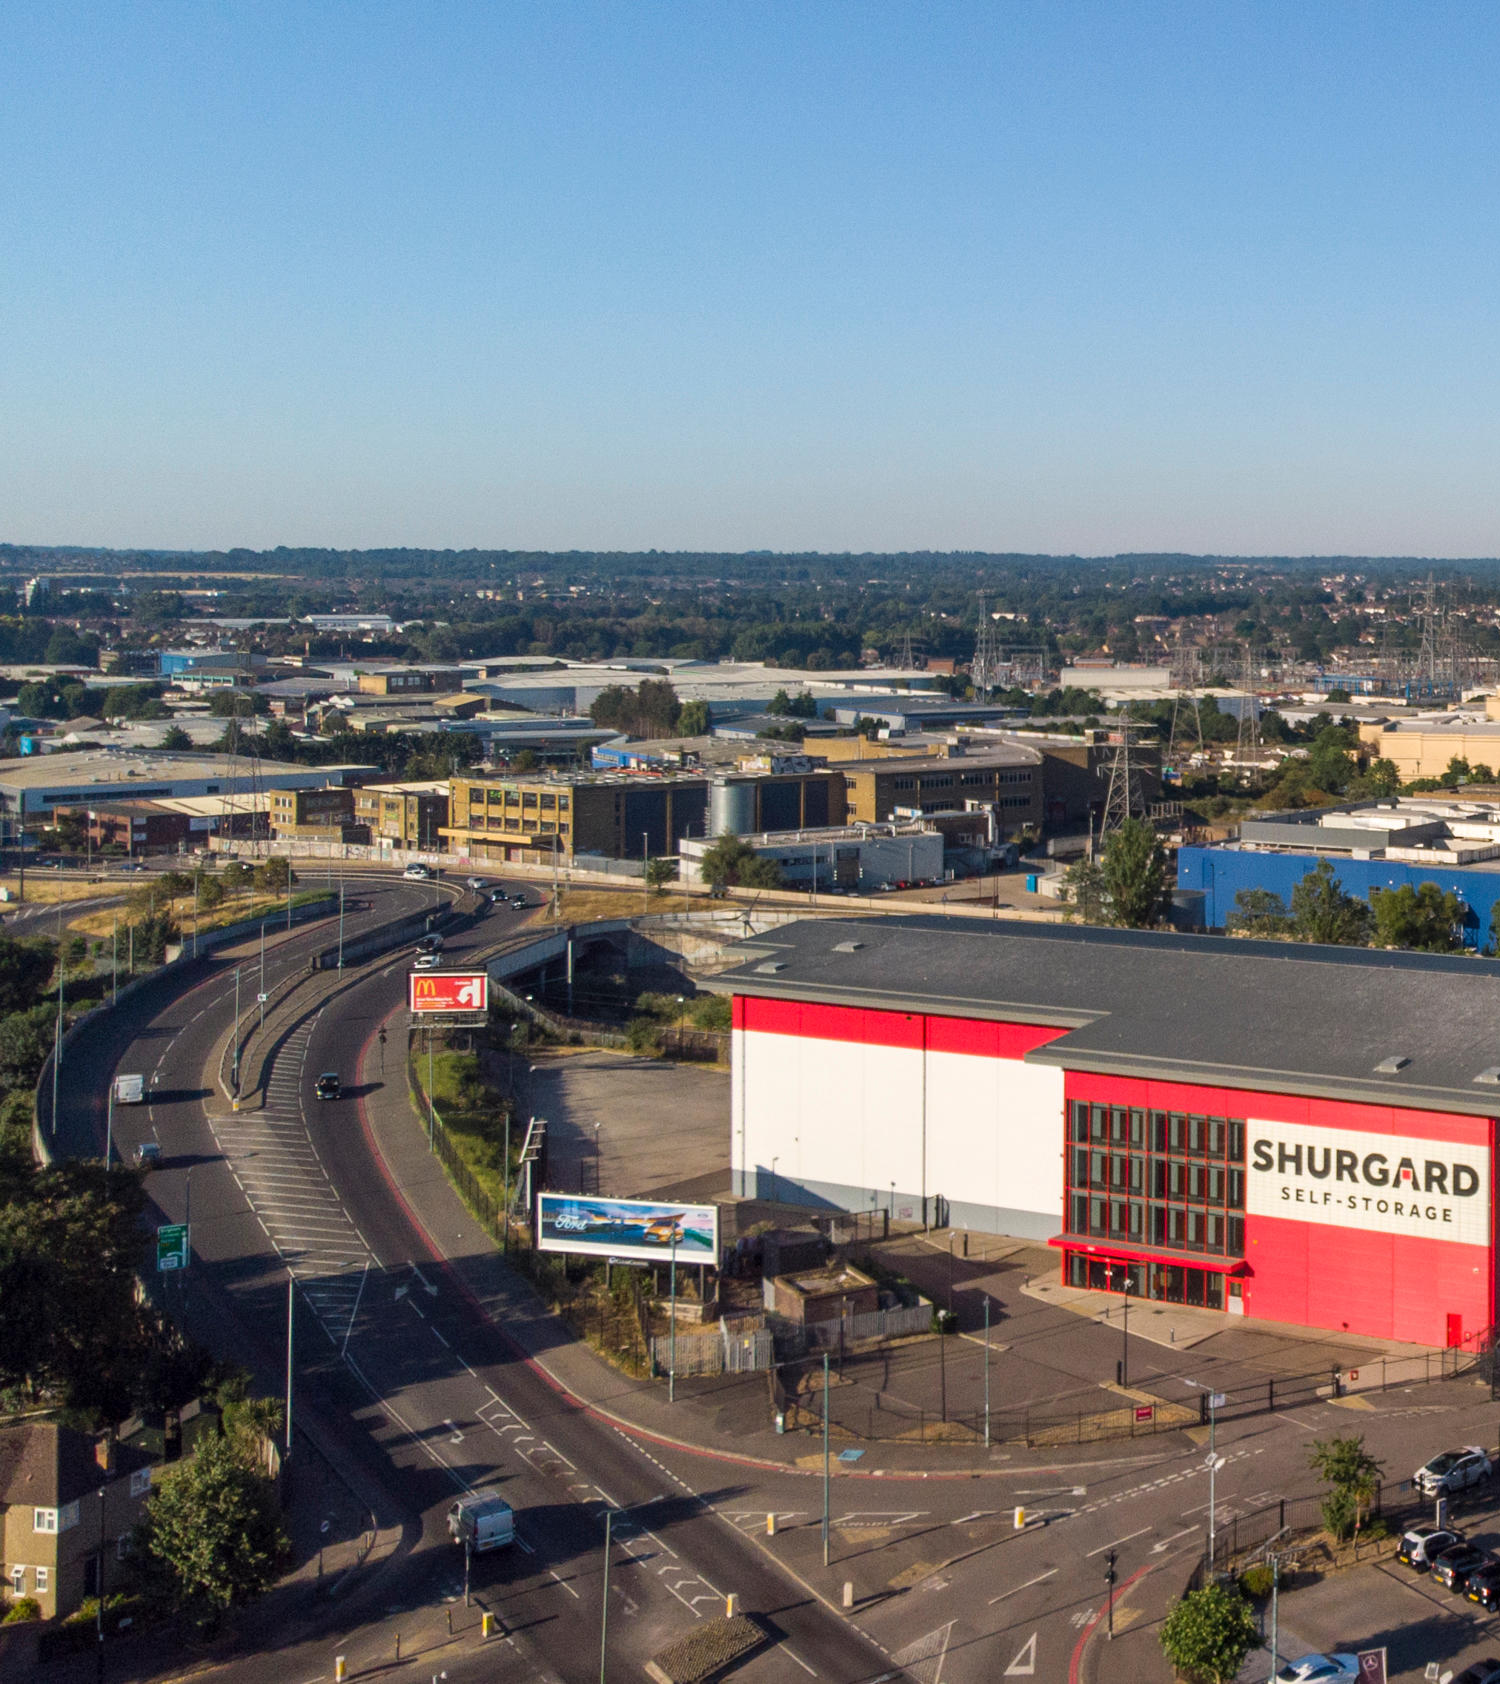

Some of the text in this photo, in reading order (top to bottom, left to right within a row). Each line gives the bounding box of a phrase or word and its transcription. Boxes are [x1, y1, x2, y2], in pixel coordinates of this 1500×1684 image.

[1252, 1139, 1480, 1197] SHURGARD
[1281, 1186, 1453, 1222] SELF-STORAGE
[555, 1214, 588, 1231] Ford
